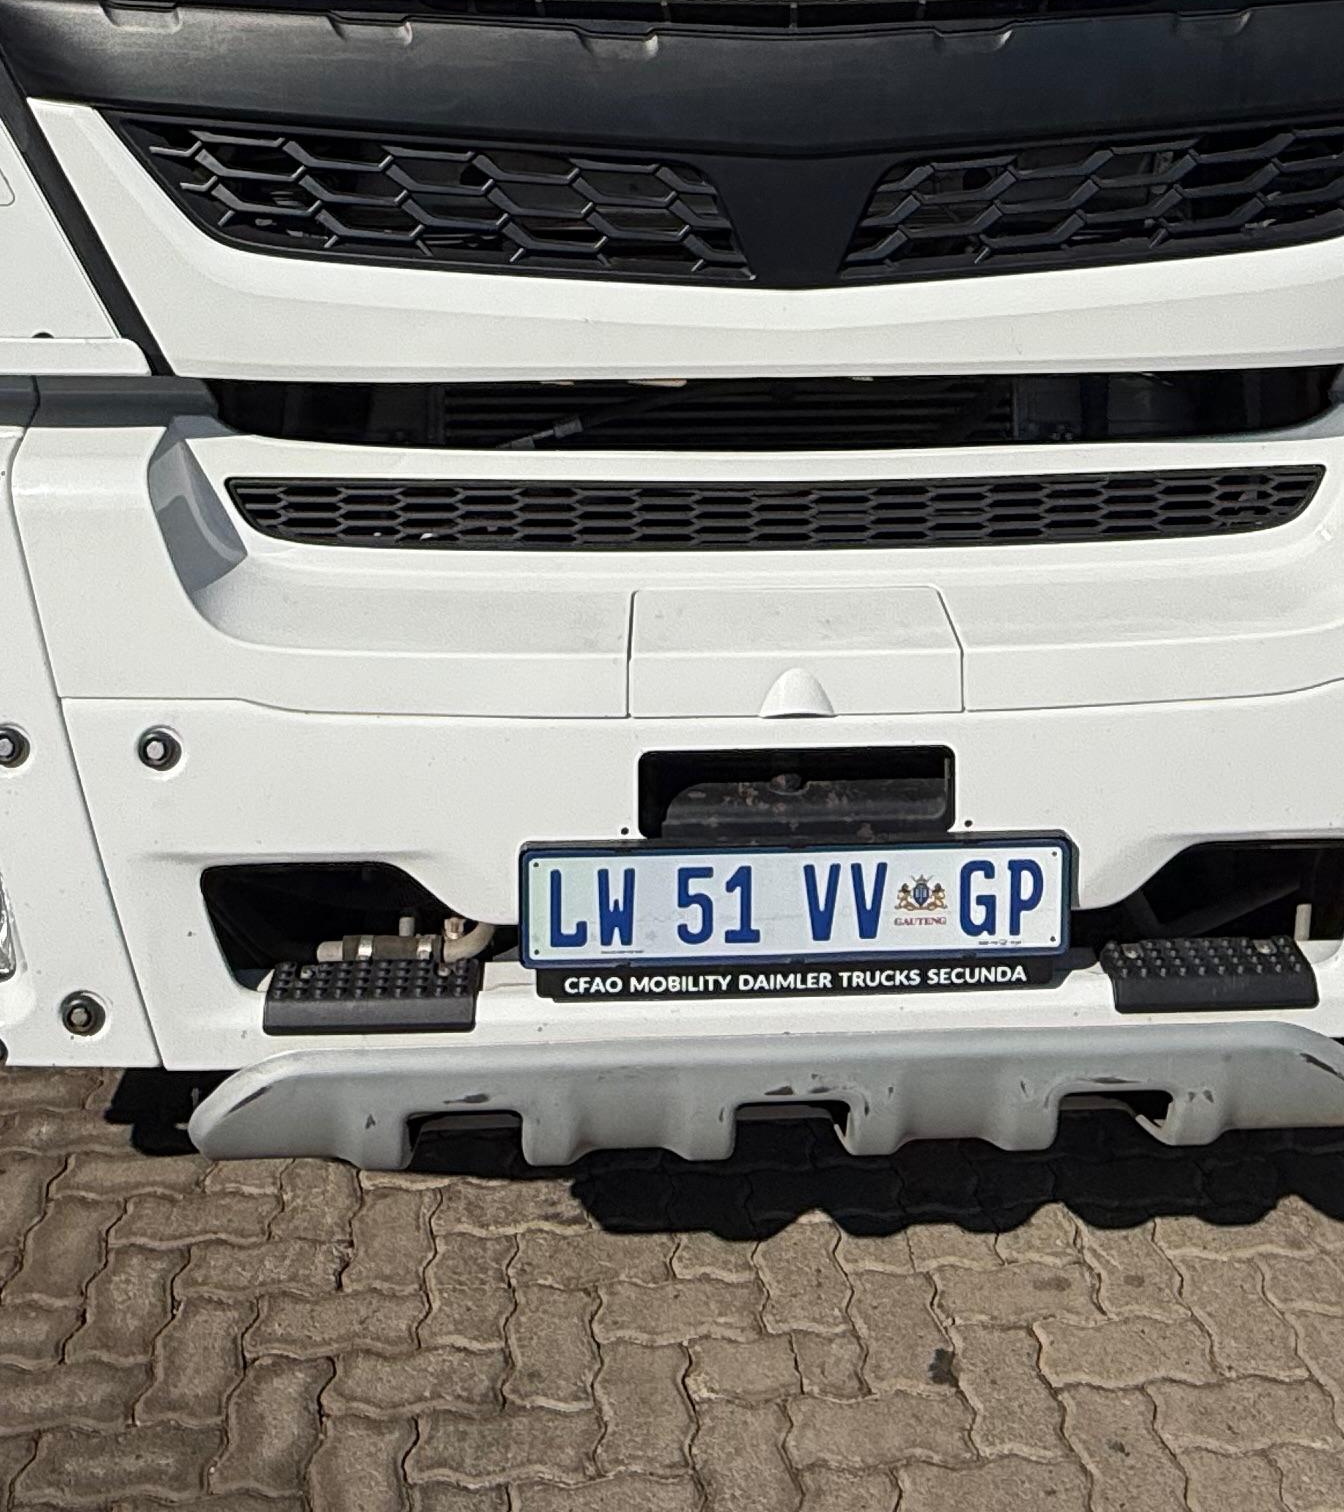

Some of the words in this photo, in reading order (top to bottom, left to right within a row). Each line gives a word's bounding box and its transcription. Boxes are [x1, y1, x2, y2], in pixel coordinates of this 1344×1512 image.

[550, 868, 636, 947] LW
[677, 865, 761, 945] 51
[803, 862, 888, 941] VV
[959, 859, 1045, 937] GP
[893, 916, 947, 926] GAUTENG
[563, 975, 623, 994] CFAO
[629, 974, 732, 993] MOBILITY
[738, 971, 833, 990] DAIMLER
[838, 968, 921, 988] TRUCKS
[927, 965, 1028, 985] SECUNDA
